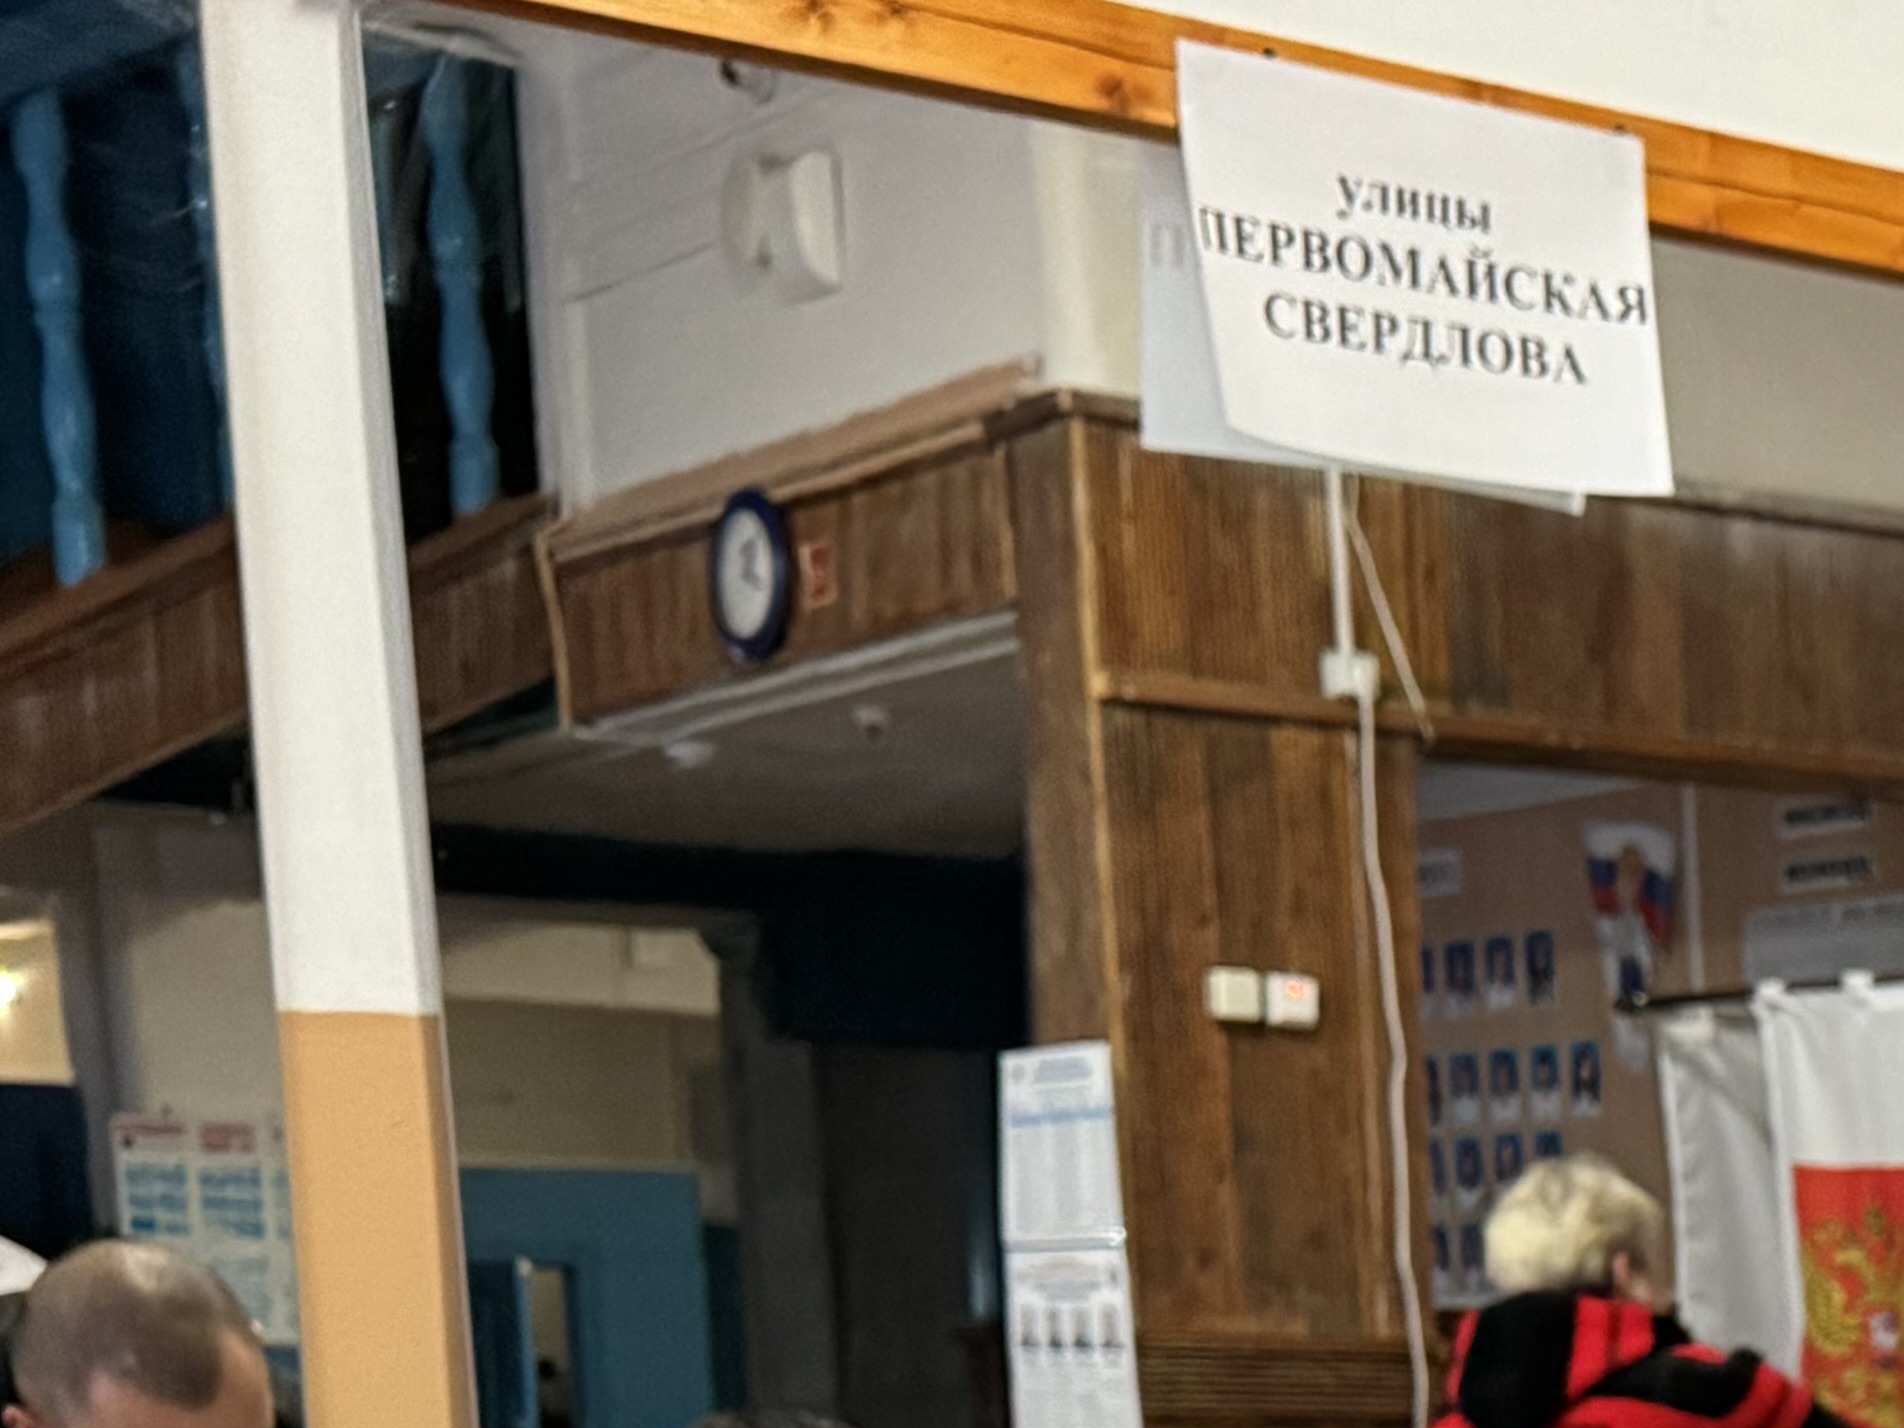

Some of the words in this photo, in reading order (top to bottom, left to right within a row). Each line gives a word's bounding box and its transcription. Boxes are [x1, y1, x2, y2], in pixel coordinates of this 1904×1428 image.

[1336, 172, 1494, 233] улицы
[1200, 207, 1648, 325] ПЕРВОМАЙСКАЯ
[1264, 291, 1588, 386] СВЕРДЛОВА
